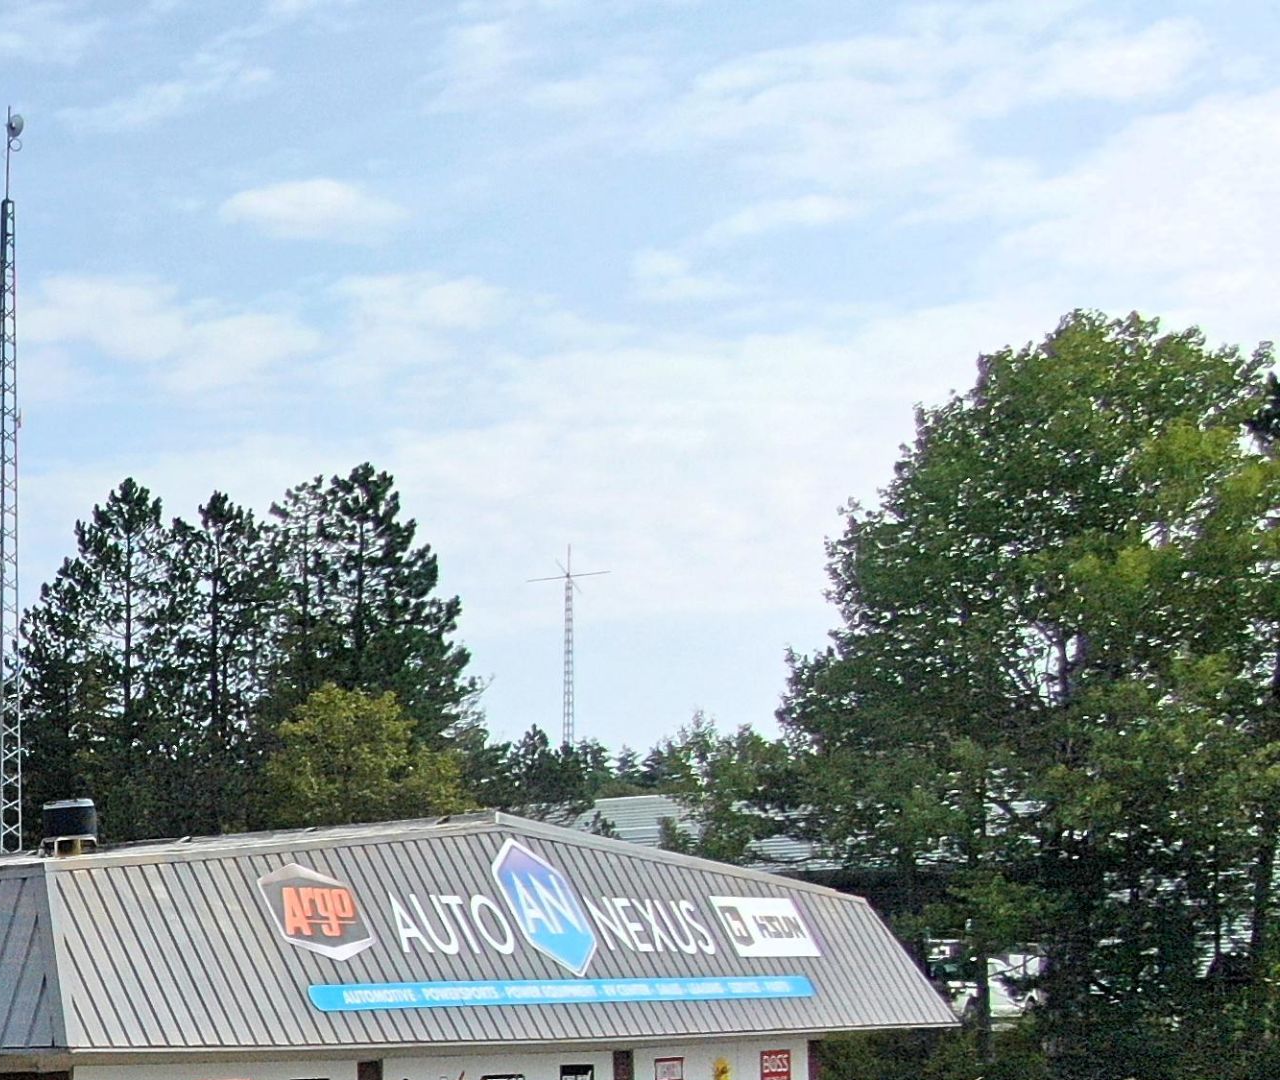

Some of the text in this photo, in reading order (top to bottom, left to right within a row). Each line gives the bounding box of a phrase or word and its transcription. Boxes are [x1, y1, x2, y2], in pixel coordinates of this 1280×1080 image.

[282, 887, 355, 936] Argo
[388, 871, 716, 955] AUTO AN NEXUS
[343, 988, 416, 1004] AUTOMOTIVE
[763, 1054, 789, 1073] BOSS
